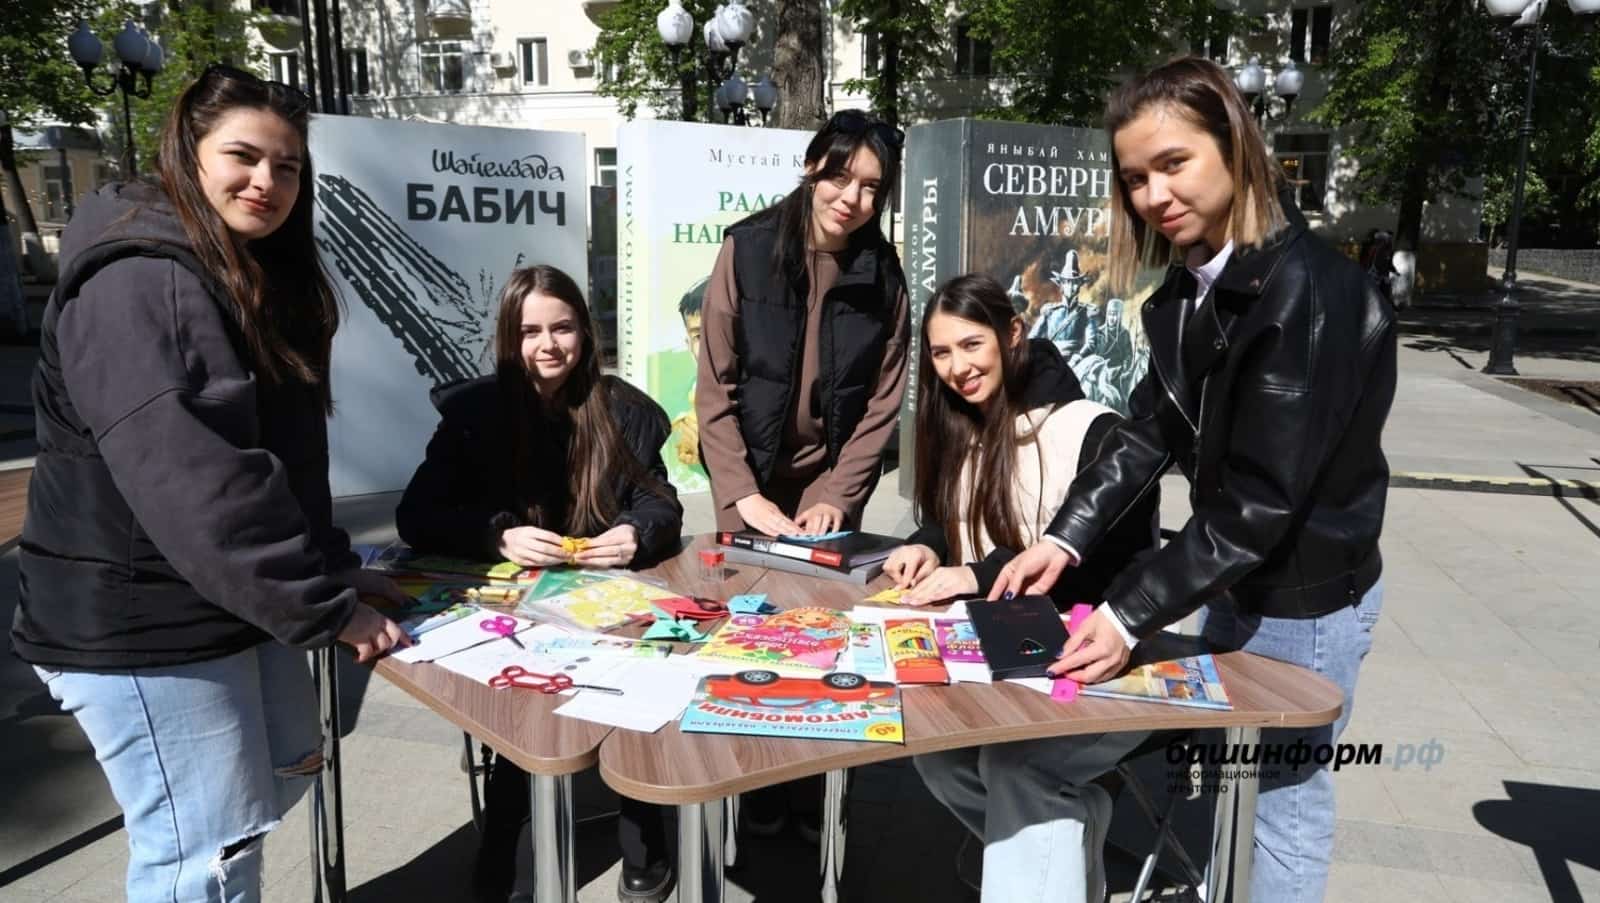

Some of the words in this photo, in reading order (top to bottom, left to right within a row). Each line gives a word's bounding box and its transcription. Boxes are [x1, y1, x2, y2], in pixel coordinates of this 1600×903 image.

[709, 148, 780, 168] Мустай
[987, 143, 1058, 159] ЯНЫБАЙ
[983, 163, 1112, 198] СЕВЕРН
[406, 183, 567, 226] БАБИЧ
[921, 177, 939, 294] АМУРЫ
[698, 702, 869, 723] АВТОМОБИЛИ
